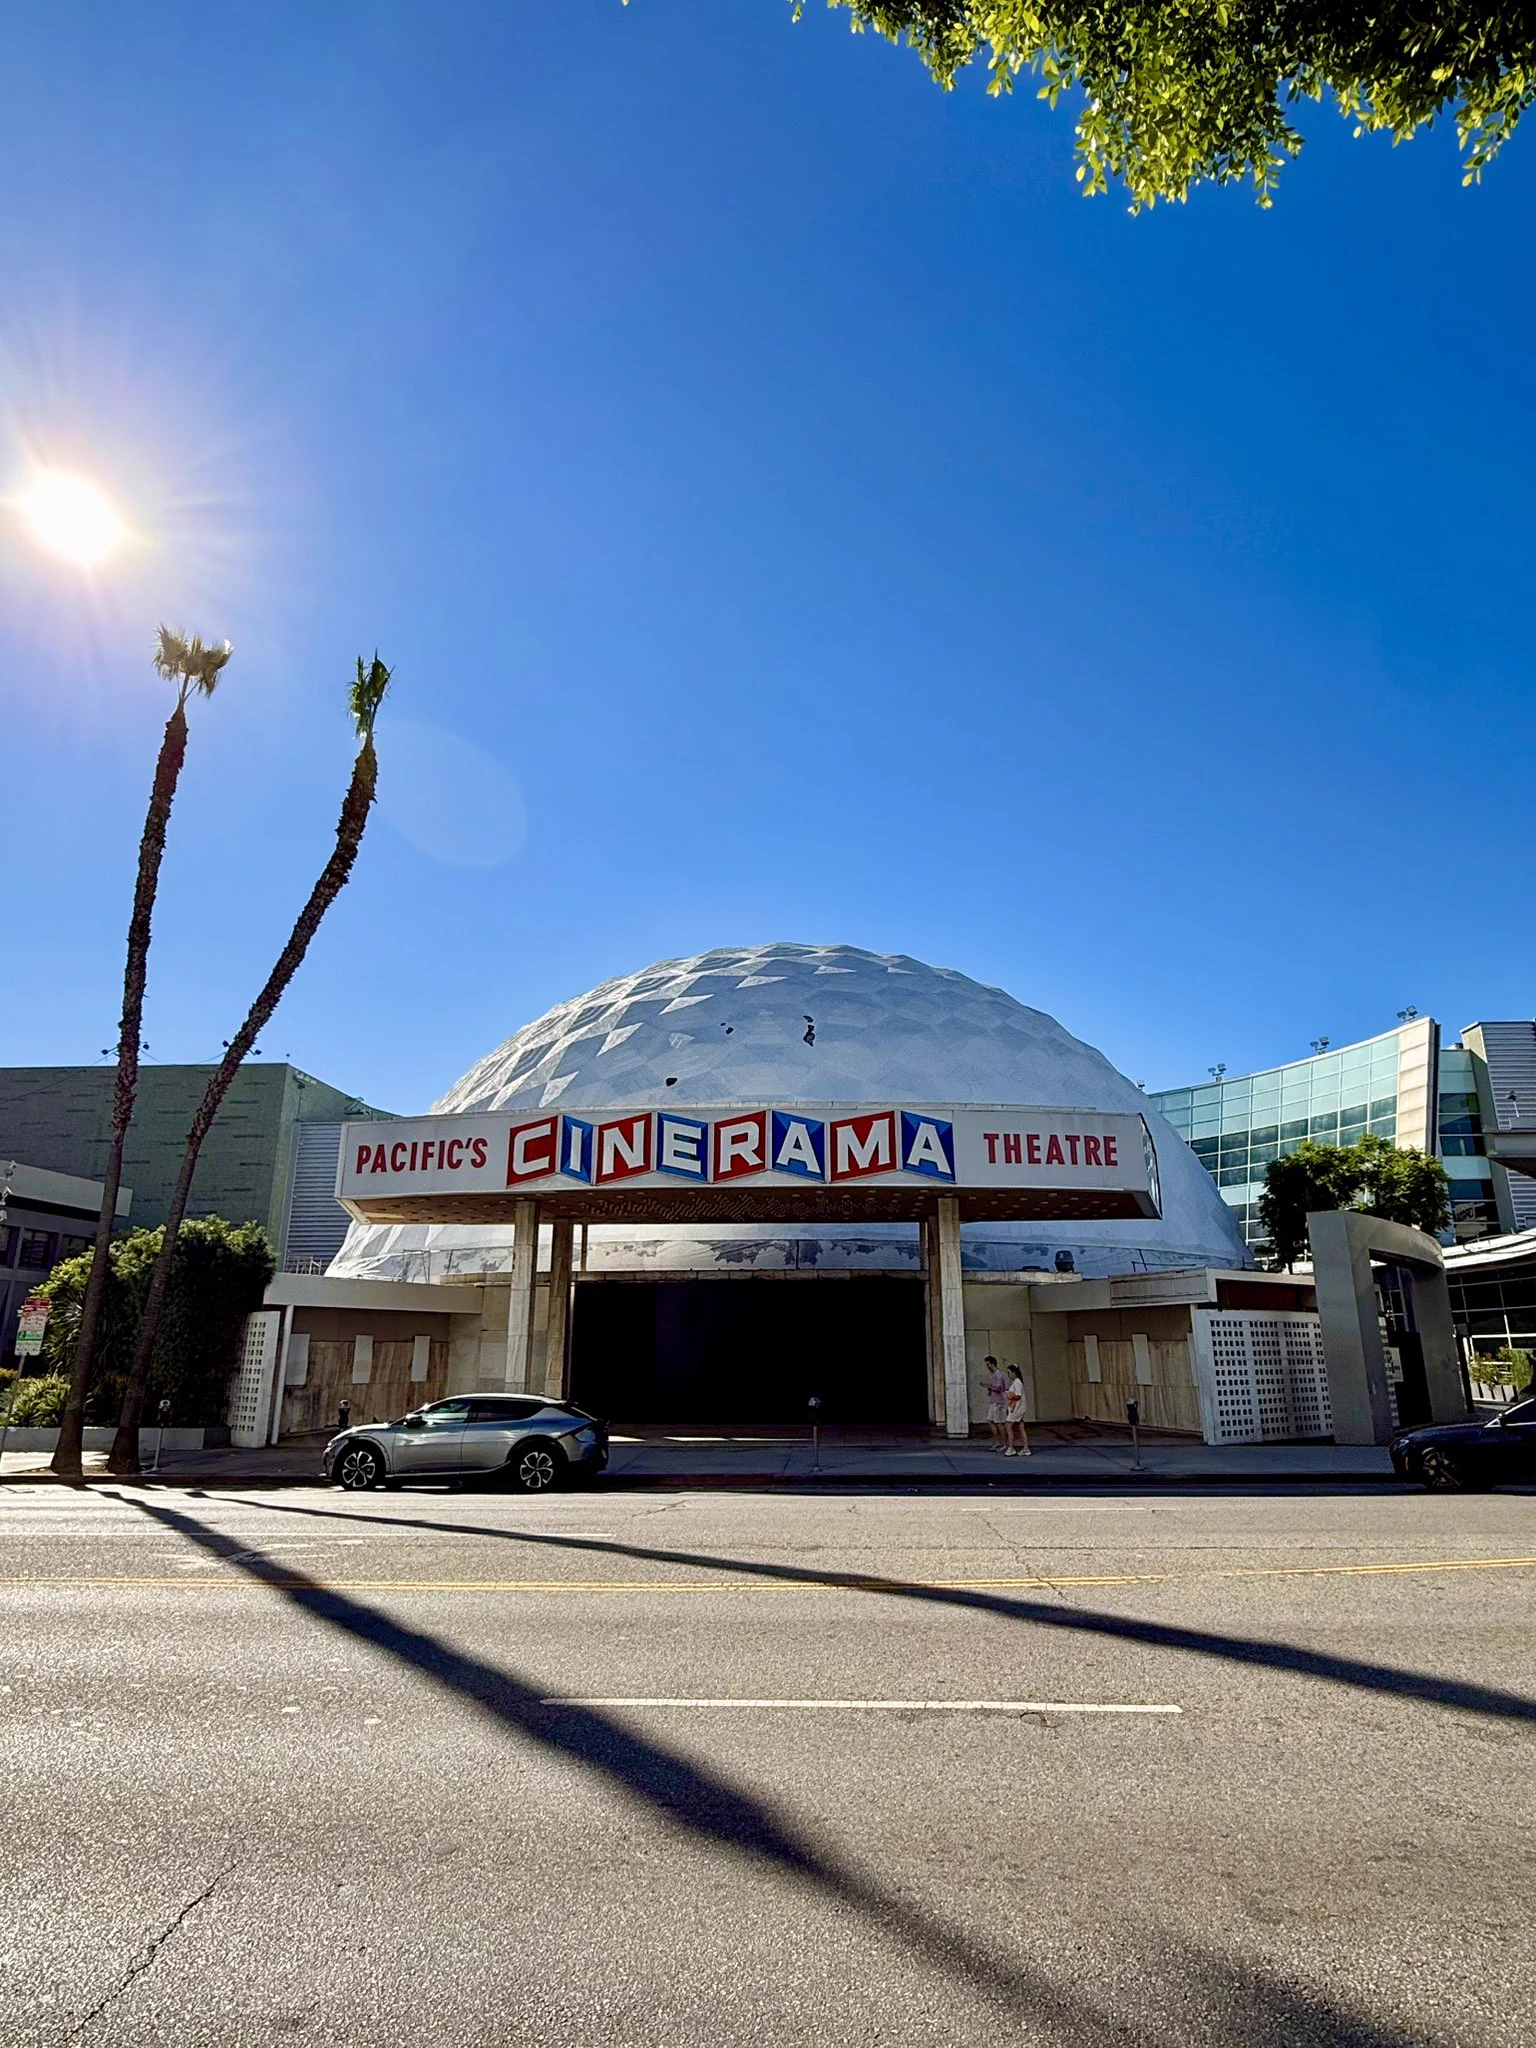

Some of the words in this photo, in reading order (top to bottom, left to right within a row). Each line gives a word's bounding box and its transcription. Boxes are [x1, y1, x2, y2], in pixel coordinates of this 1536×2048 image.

[356, 1137, 488, 1174] PACIFIC'S
[512, 1118, 952, 1175] CINERAMA
[983, 1132, 1119, 1167] THEATRE
